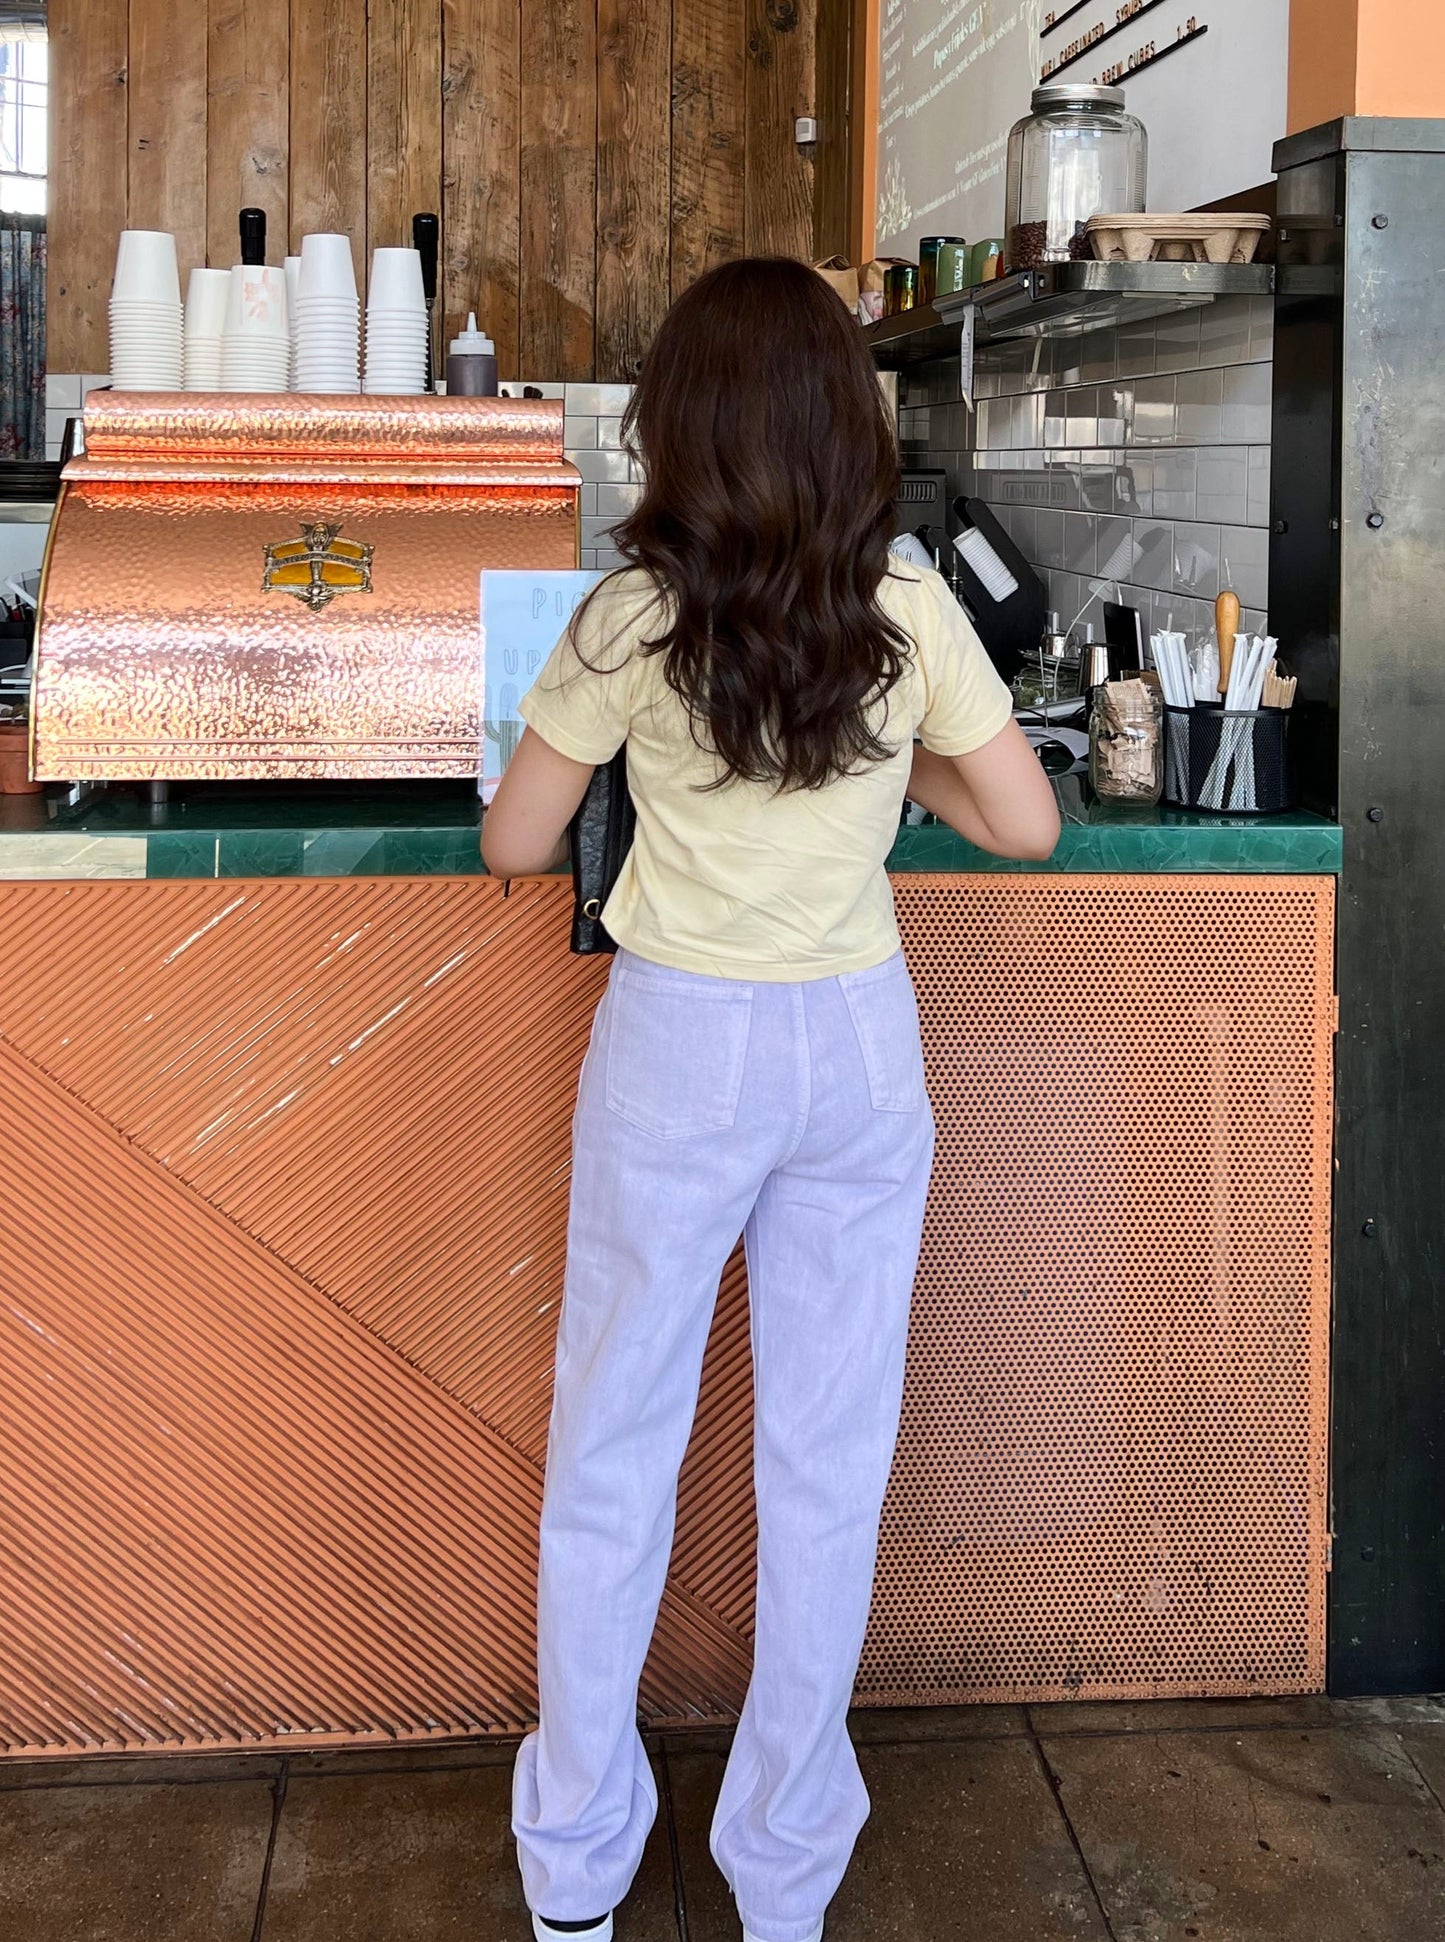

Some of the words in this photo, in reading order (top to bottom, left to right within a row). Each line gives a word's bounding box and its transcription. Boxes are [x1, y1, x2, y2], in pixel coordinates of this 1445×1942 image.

[1128, 40, 1155, 70] CUBES
[532, 587, 586, 619] PIC
[503, 648, 541, 675] UP
